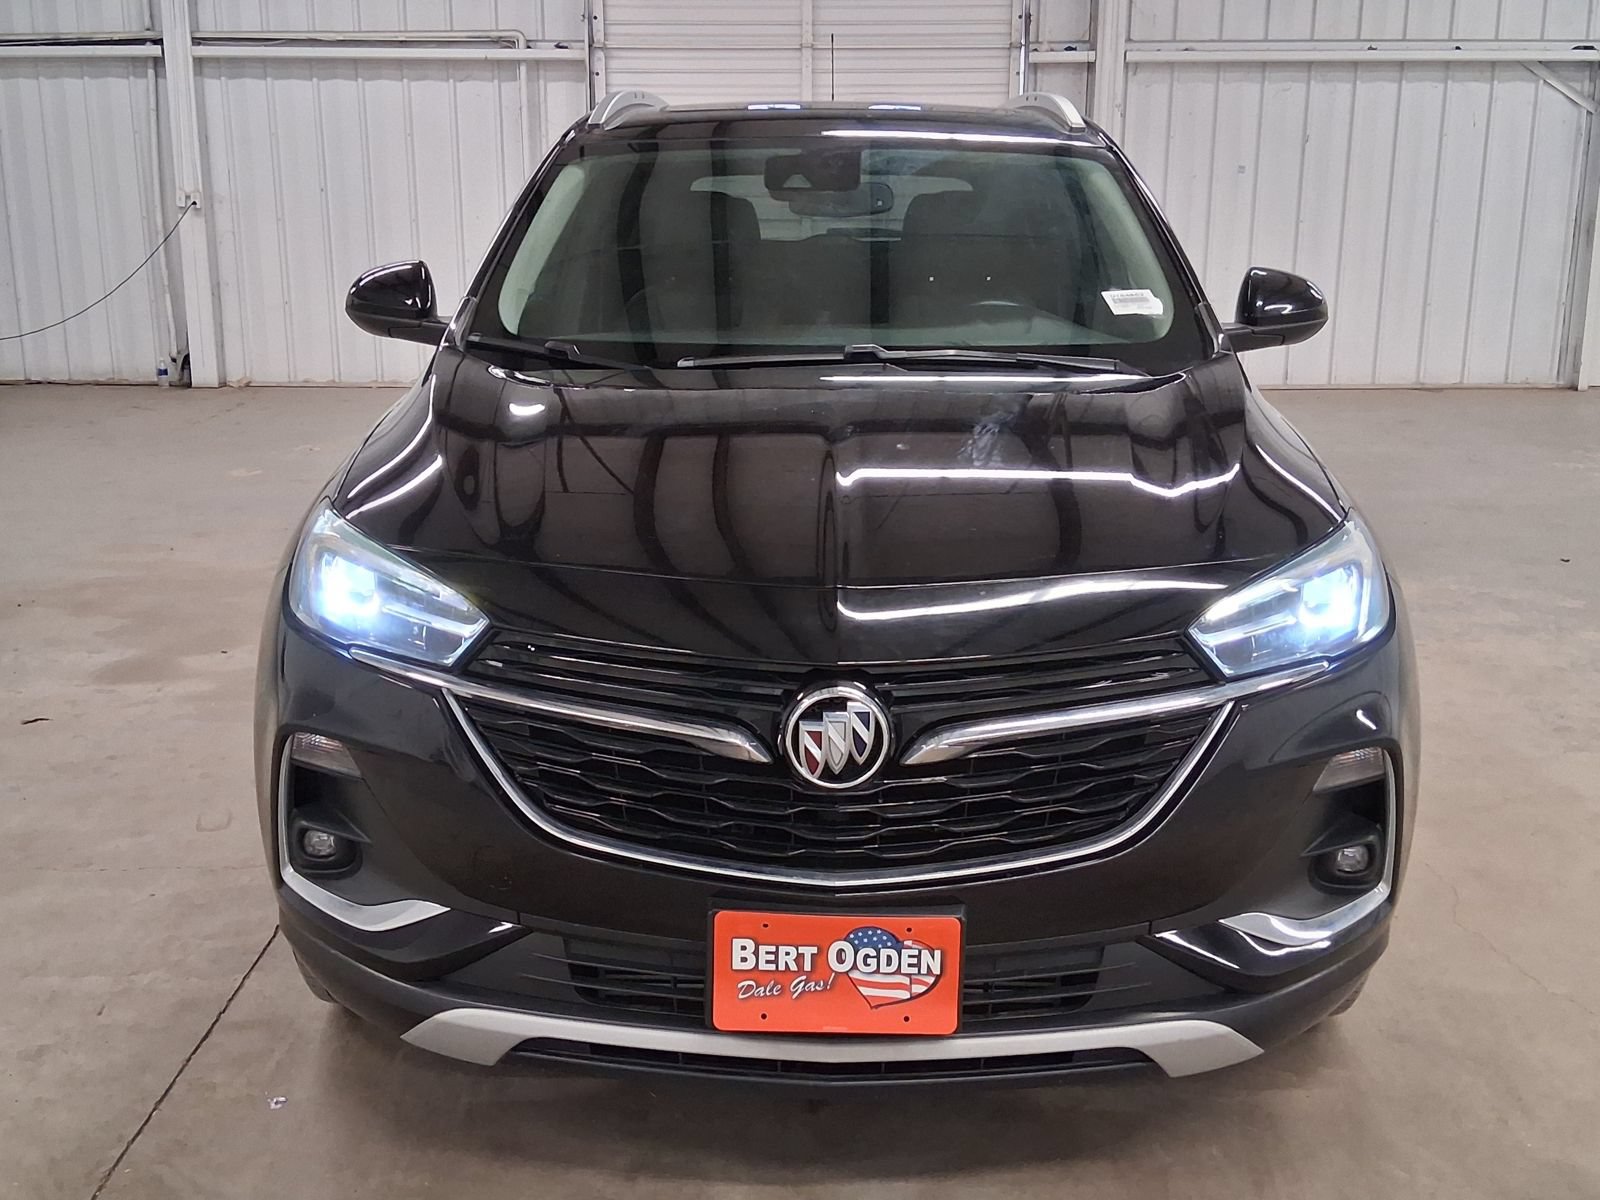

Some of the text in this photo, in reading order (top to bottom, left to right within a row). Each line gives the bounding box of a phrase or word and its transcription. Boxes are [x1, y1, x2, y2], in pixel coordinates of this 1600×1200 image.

[731, 938, 942, 975] BERT OGDEN
[737, 972, 835, 999] Dale Gas!
